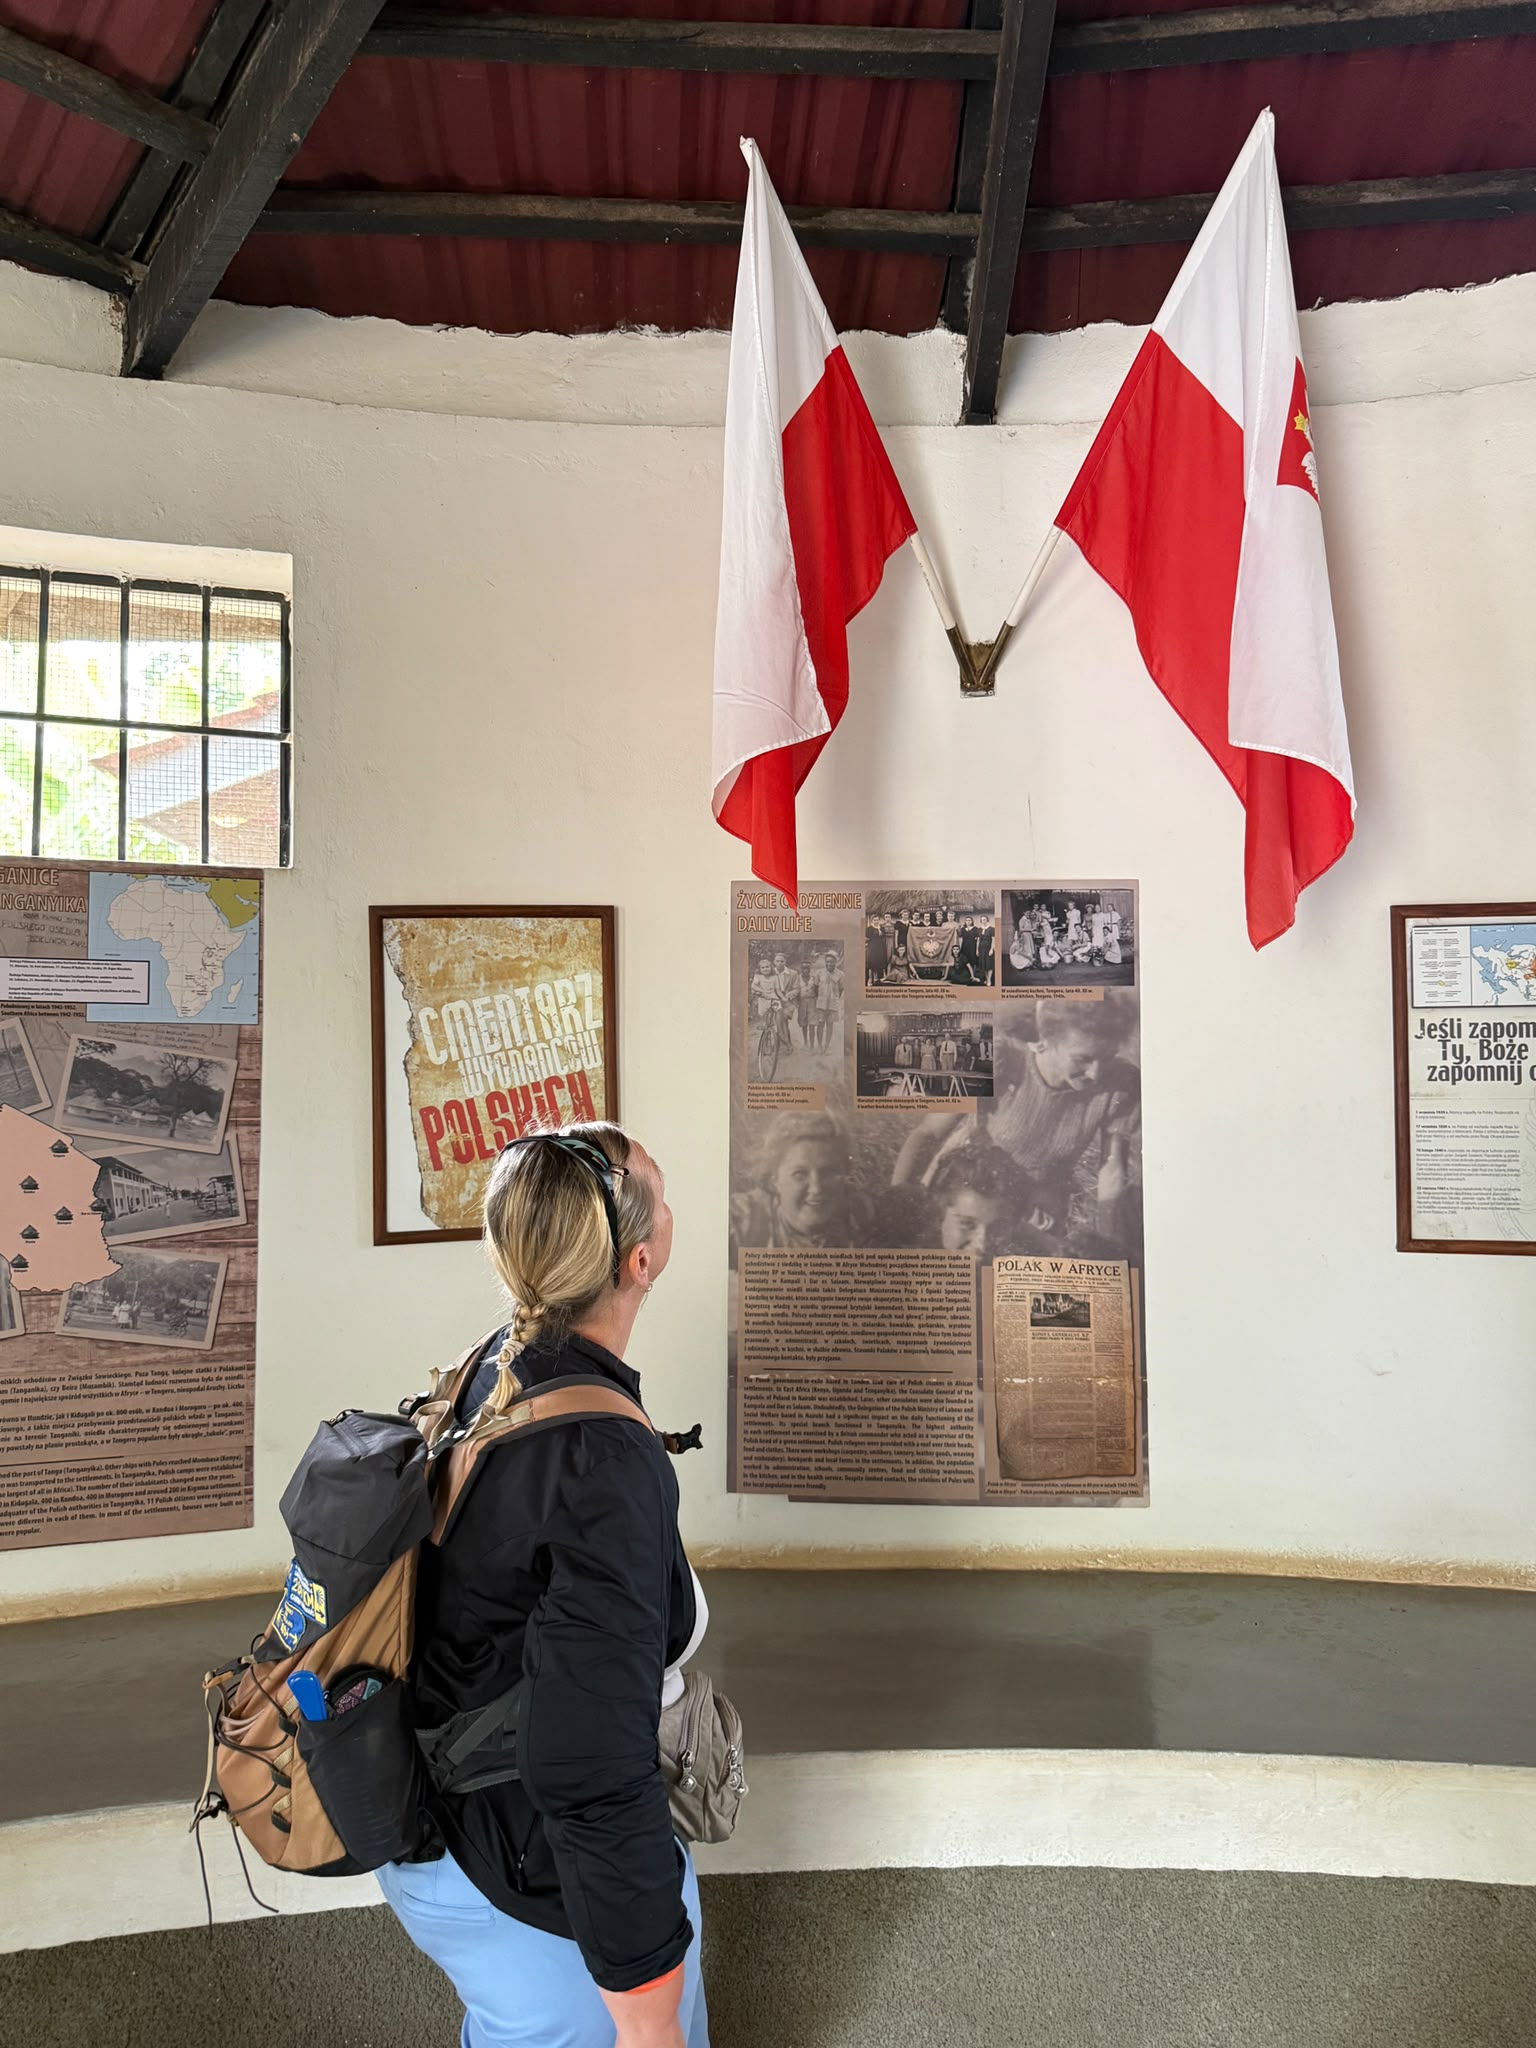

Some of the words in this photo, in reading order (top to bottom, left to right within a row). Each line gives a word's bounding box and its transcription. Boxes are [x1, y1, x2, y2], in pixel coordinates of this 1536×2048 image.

[0, 894, 86, 912] NGANYIKA
[737, 890, 776, 909] ŻYCIE
[780, 893, 862, 910] CDZIENNE
[738, 916, 778, 932] DAILY
[782, 916, 812, 932] LIFE
[418, 972, 603, 1065] CMENTARZ
[1414, 1018, 1462, 1040] Jeśli
[1438, 1039, 1471, 1064] Ty,
[1479, 1039, 1529, 1060] Boże
[1427, 1060, 1522, 1086] zapomnij
[998, 1260, 1042, 1272] POLAK
[1050, 1262, 1063, 1272] W
[1068, 1264, 1120, 1276] AFRYCE
[20, 1478, 55, 1488] transported
[76, 1473, 113, 1482] settlements.
[122, 1470, 157, 1480] Tanganyika,
[211, 1463, 243, 1471] established
[45, 1468, 62, 1476] Tanga
[7, 1489, 28, 1498] largest
[135, 1478, 168, 1487] inhabitants
[170, 1476, 194, 1485] changed
[18, 1517, 44, 1525] different
[144, 1505, 181, 1515] settlements,
[16, 1528, 42, 1536] popular.
